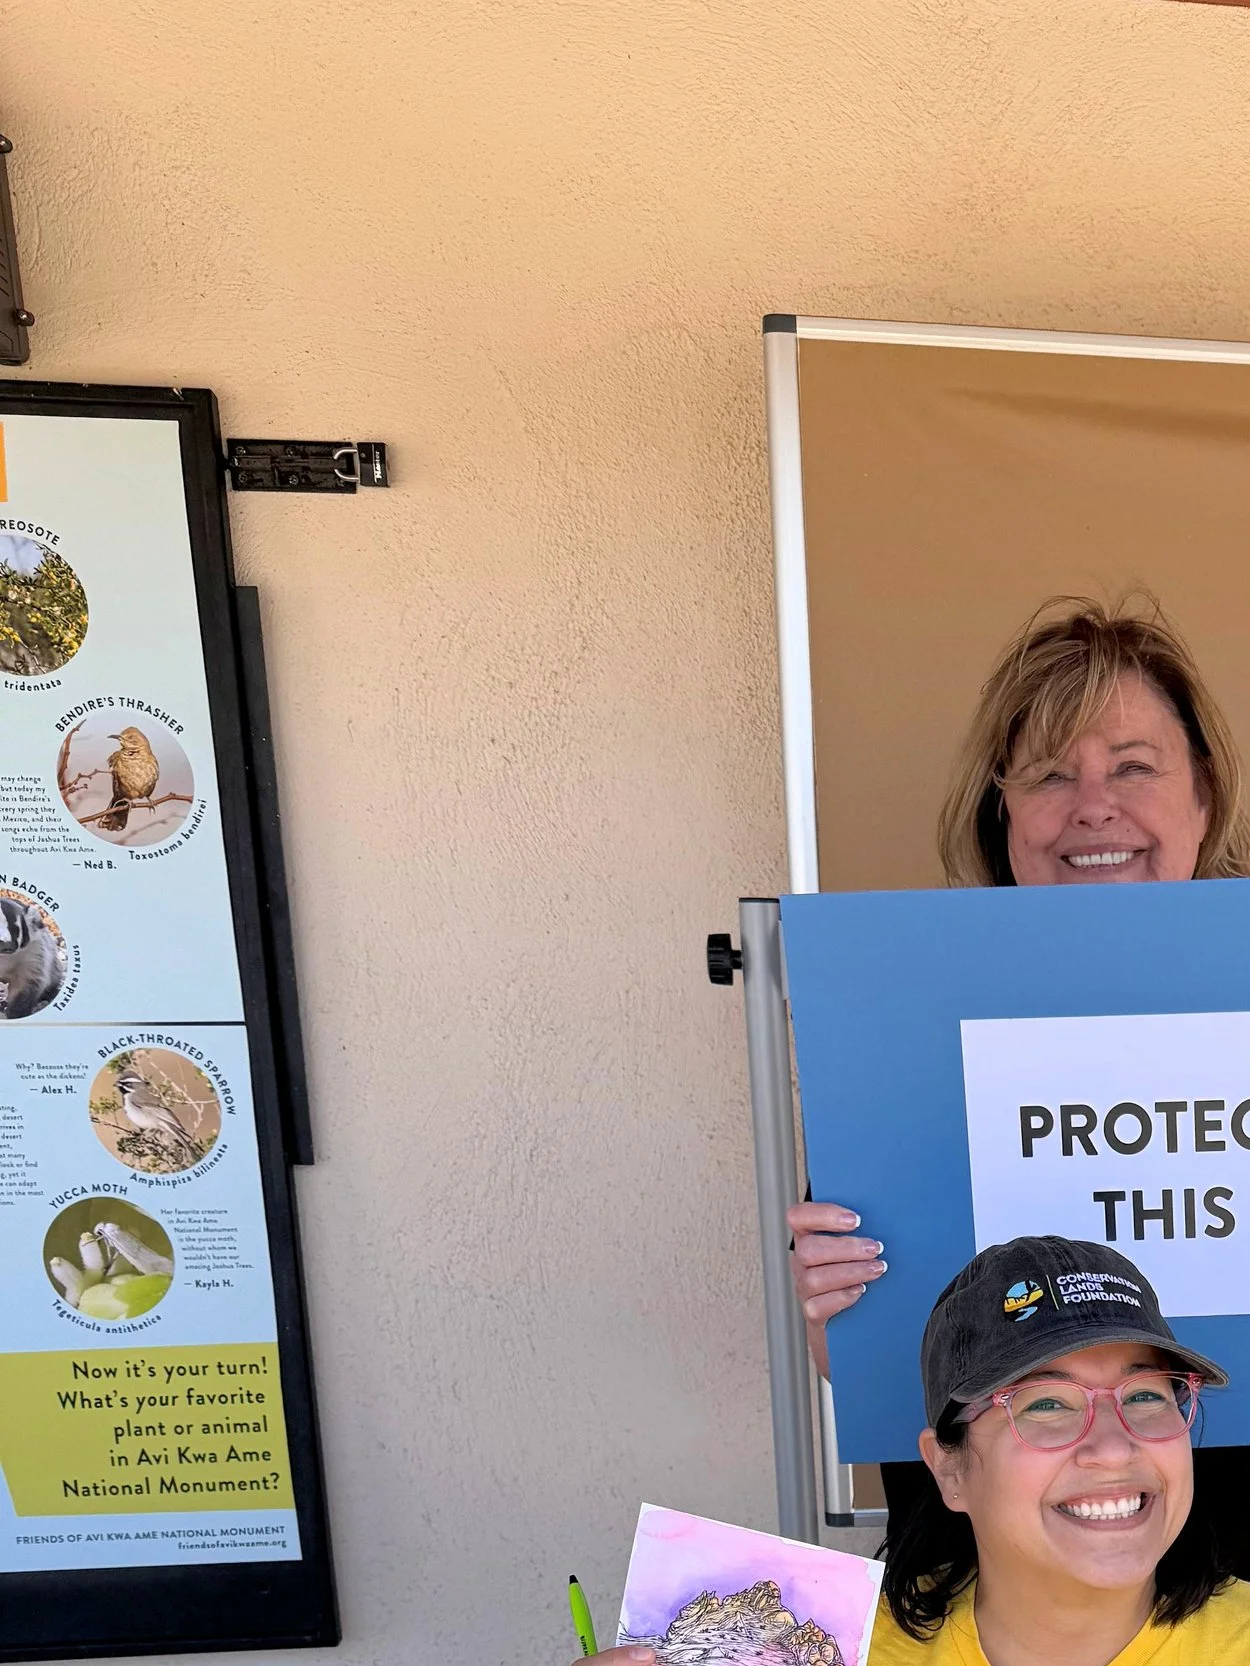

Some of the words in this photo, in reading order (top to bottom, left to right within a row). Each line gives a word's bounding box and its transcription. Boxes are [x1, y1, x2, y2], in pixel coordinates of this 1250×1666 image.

[4, 680, 62, 691] tridentata
[55, 697, 115, 732] BENDIRE'S
[119, 697, 184, 735] THRASHER
[128, 840, 183, 860] Toxostoma
[181, 799, 208, 840] bendirei
[84, 860, 104, 870] Ned
[107, 860, 117, 870] B.
[12, 877, 60, 912] BADGER
[53, 977, 79, 1011] Taxidea
[72, 945, 81, 973] taxus
[97, 1033, 204, 1061] BLACK-THROATED
[203, 1060, 236, 1115] SPARROW
[41, 1086, 63, 1094] Alex
[65, 1085, 77, 1094] H.
[193, 1143, 228, 1178] bilineata
[49, 1186, 89, 1209] YUCCA
[92, 1183, 128, 1195] MOTH
[1092, 1186, 1236, 1242] THIS
[195, 1279, 220, 1291] Kayla
[222, 1279, 234, 1288] H.
[1056, 1272, 1142, 1294] CONSERVATION
[1059, 1282, 1104, 1295] LANDS
[1062, 1291, 1141, 1308] FOUNDATION
[52, 1299, 101, 1332] Tegeticula
[106, 1314, 162, 1335] antithetica
[72, 1360, 118, 1380] Now
[125, 1360, 156, 1378] it's
[163, 1362, 209, 1385] your
[216, 1356, 268, 1375] turn!
[57, 1390, 129, 1410] What's
[136, 1393, 179, 1415] your
[186, 1387, 266, 1406] favorite
[113, 1419, 167, 1444] plant
[173, 1424, 194, 1436] or
[201, 1415, 268, 1435] animal
[110, 1449, 129, 1467] in
[136, 1447, 169, 1466] Avi
[177, 1446, 218, 1464] Kwa
[225, 1445, 272, 1463] Ame
[62, 1477, 151, 1498] National
[159, 1472, 281, 1495] Monument?
[16, 1534, 64, 1545] FRIENDS
[66, 1534, 83, 1543] OF
[85, 1532, 104, 1542] AVI
[106, 1531, 132, 1541] KWA
[133, 1530, 159, 1540] AME
[161, 1528, 217, 1539] NATIONAL
[220, 1526, 285, 1537] MONUMENT
